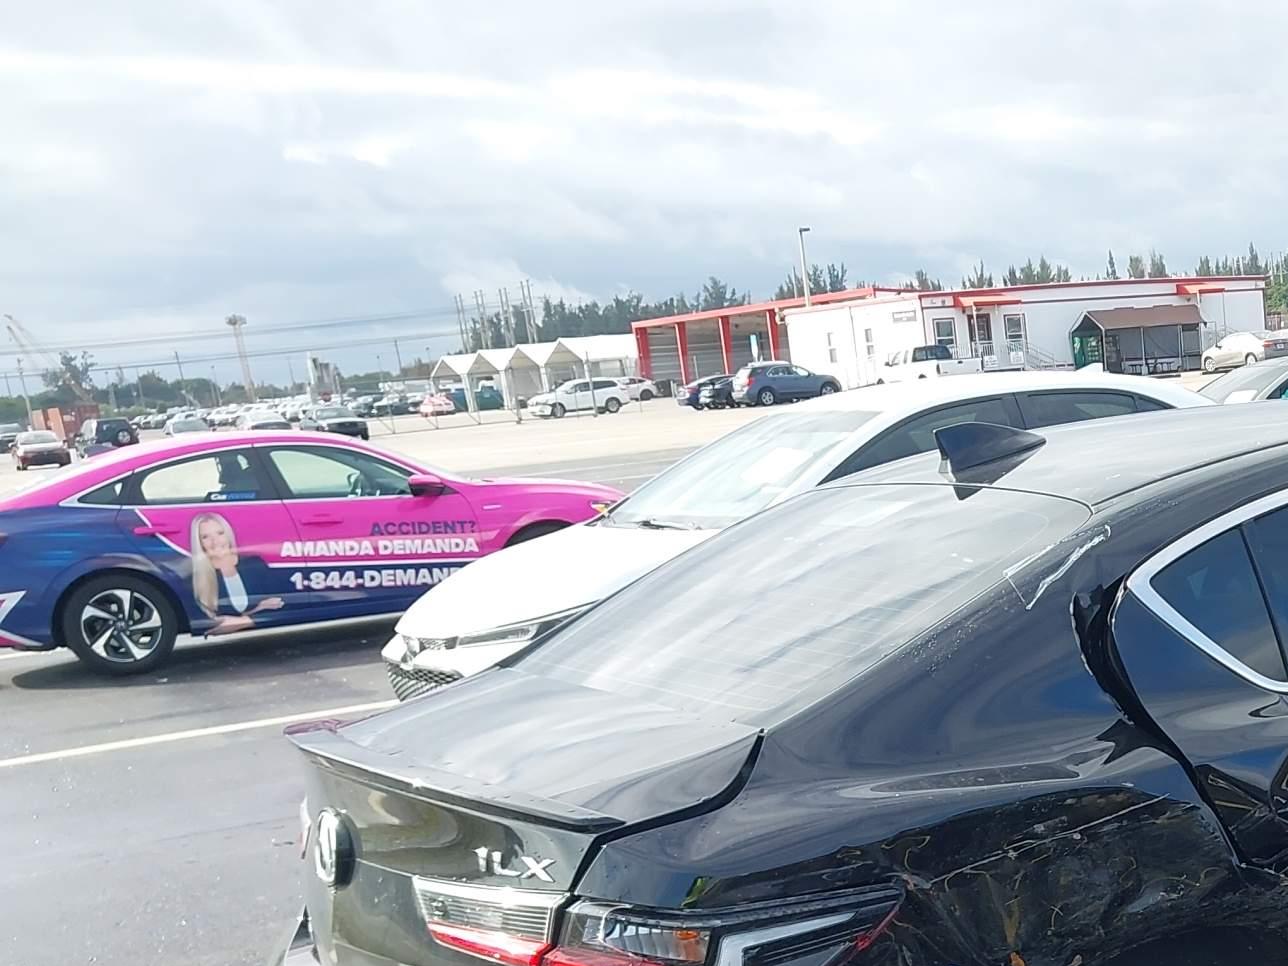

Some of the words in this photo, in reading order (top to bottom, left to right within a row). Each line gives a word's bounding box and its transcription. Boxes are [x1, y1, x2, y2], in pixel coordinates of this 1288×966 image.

[371, 521, 476, 536] ACCIDENT?
[281, 541, 375, 557] AMANDA
[378, 538, 479, 555] DEMANDA
[473, 846, 555, 883] ILX
